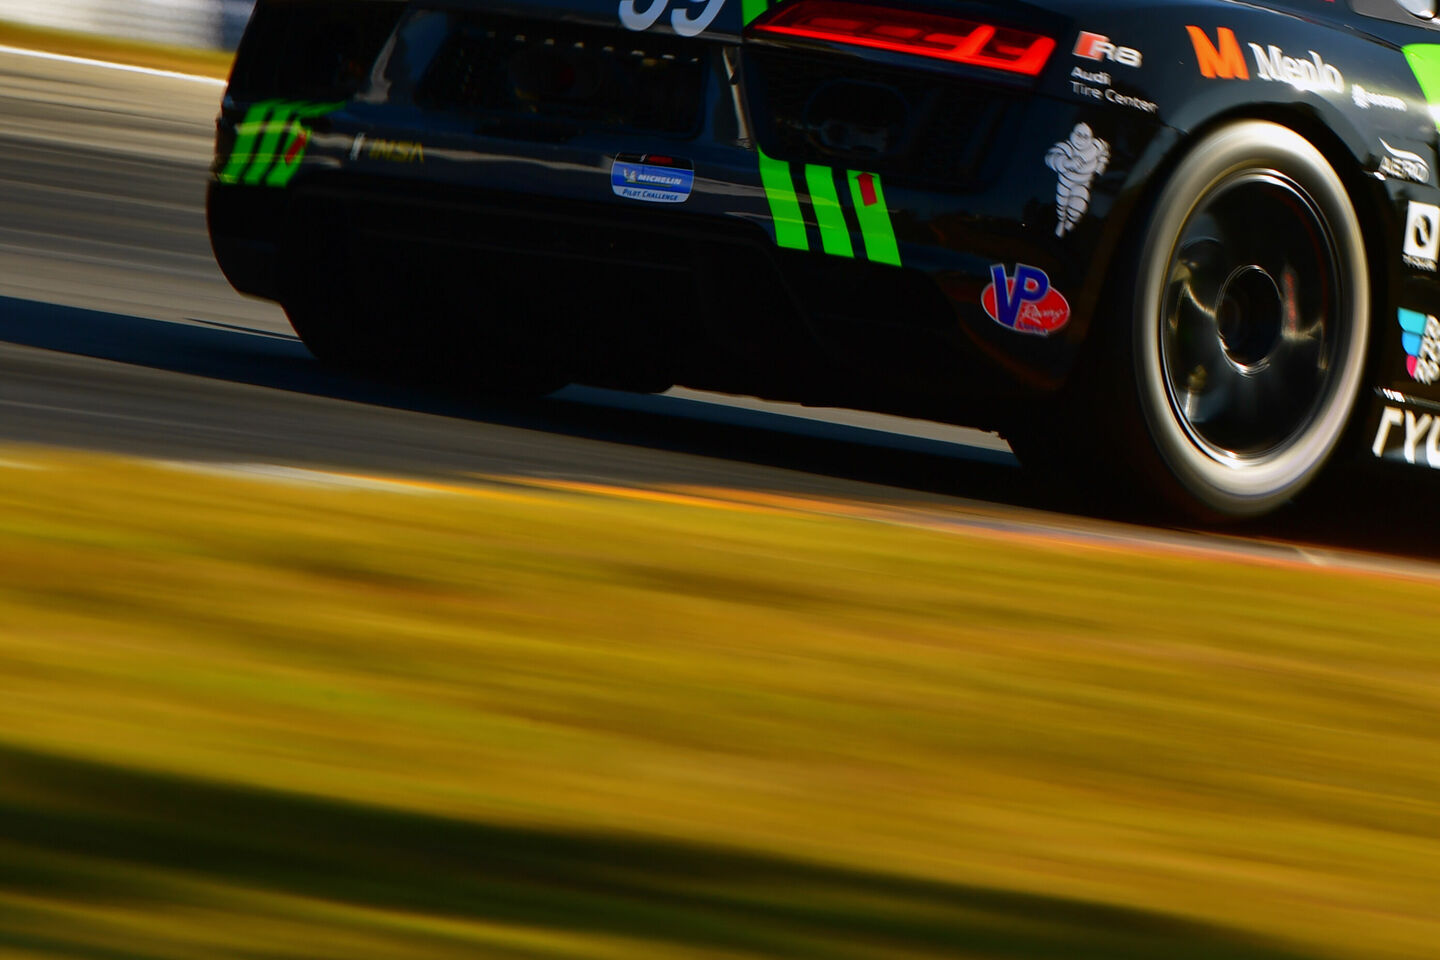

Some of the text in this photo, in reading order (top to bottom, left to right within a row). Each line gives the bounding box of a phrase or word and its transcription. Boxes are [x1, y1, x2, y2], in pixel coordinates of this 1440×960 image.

[1088, 40, 1143, 68] R8
[1070, 66, 1112, 86] Audi
[1070, 80, 1159, 114] Tire Center
[637, 174, 682, 185] MICHELIN
[990, 263, 1050, 328] VP
